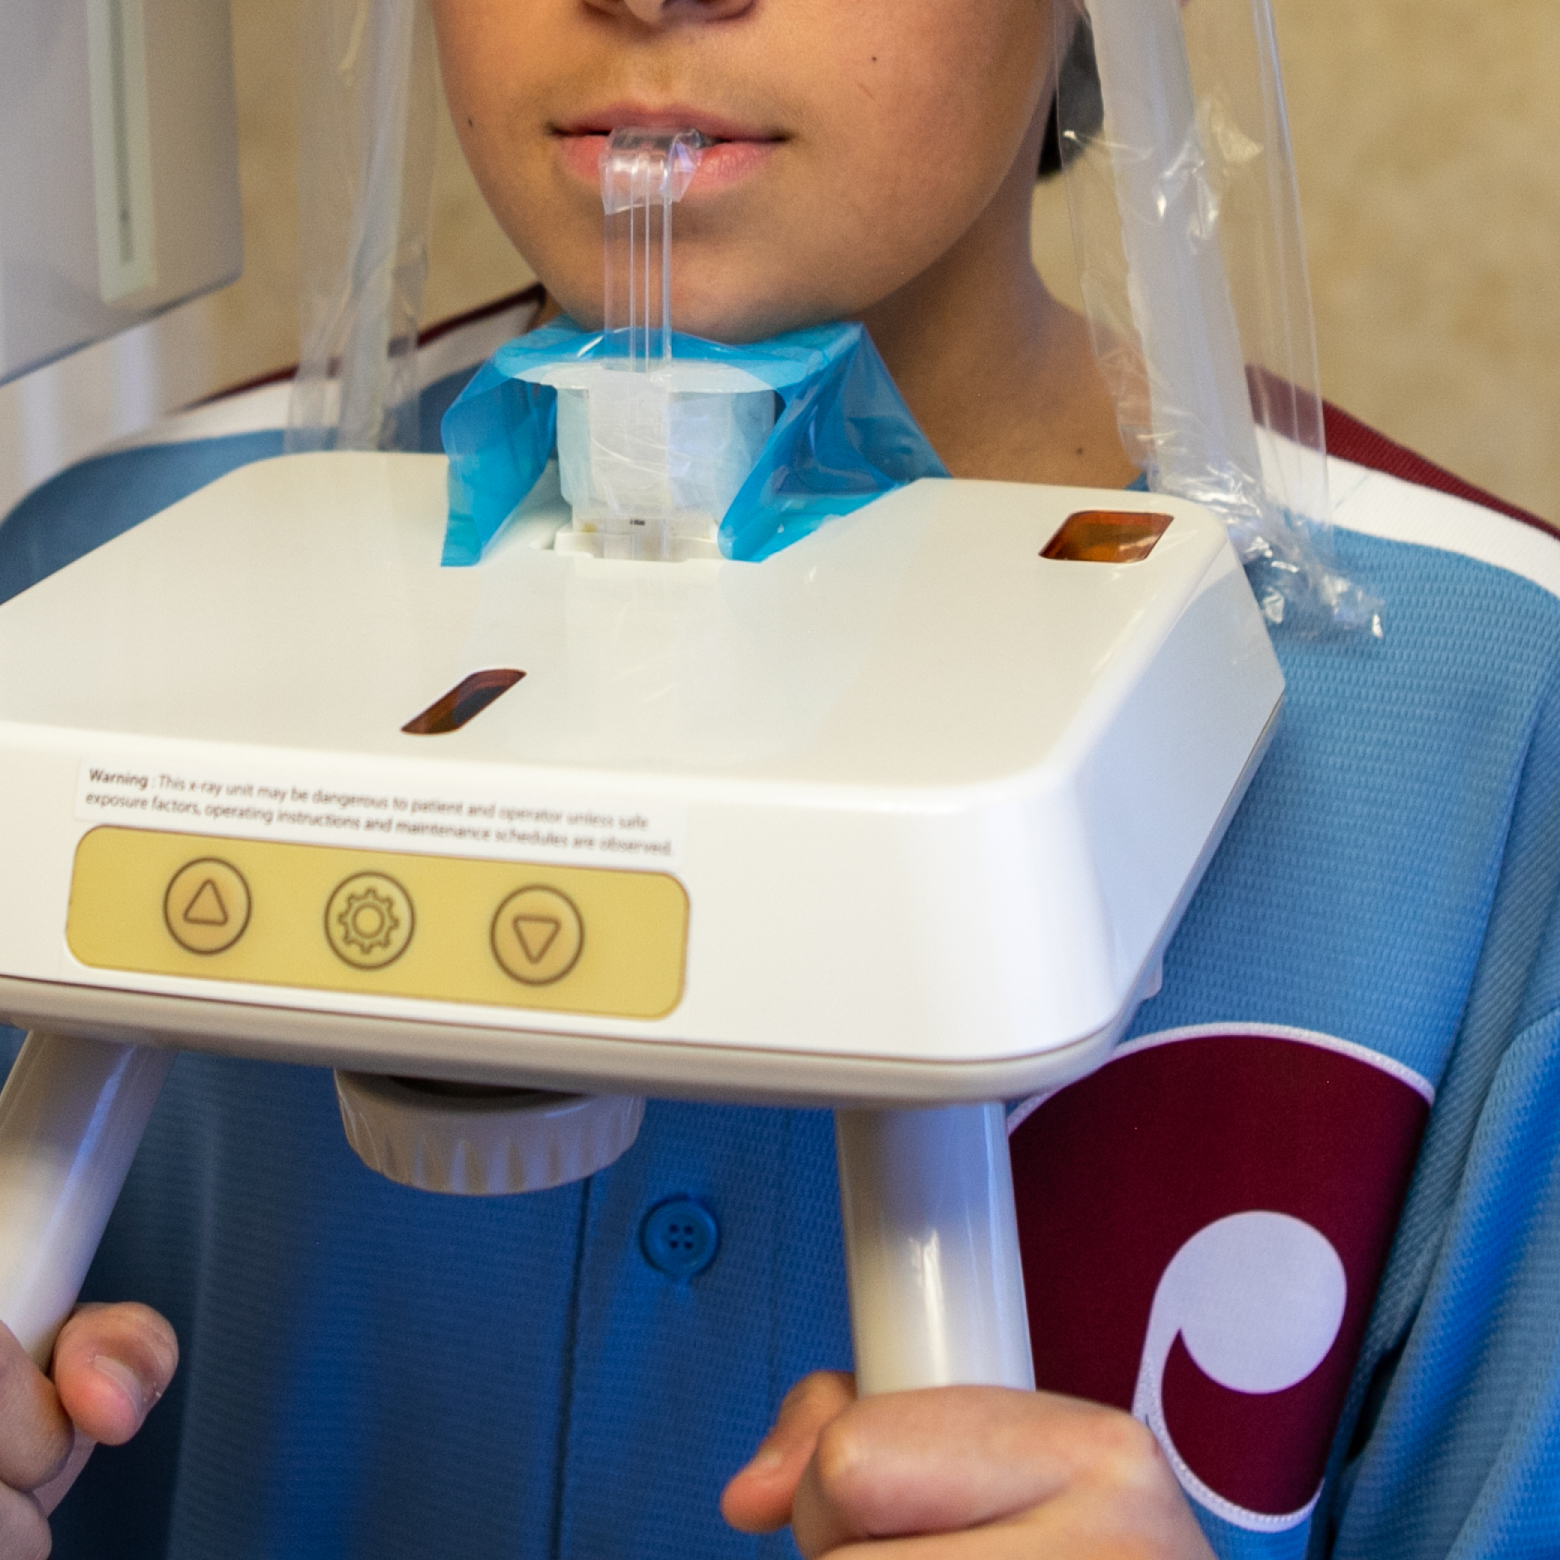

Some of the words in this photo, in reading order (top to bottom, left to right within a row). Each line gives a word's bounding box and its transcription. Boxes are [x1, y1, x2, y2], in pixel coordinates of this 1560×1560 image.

[85, 793, 148, 812] exposure
[151, 796, 202, 817] factors,
[204, 803, 272, 825] operating
[277, 809, 360, 831] instructions
[364, 817, 392, 833] and
[395, 820, 490, 841] maintenance
[572, 835, 595, 850] are
[90, 768, 148, 790] Warning
[159, 775, 184, 791] This
[189, 779, 222, 797] x-ray
[226, 782, 253, 798] unit
[257, 787, 286, 802] may
[291, 787, 308, 801] be
[312, 789, 388, 810] dangerous
[392, 796, 408, 810] to
[411, 798, 463, 816] patient
[467, 802, 495, 819] and
[498, 806, 562, 824] operator
[618, 814, 648, 830] safe
